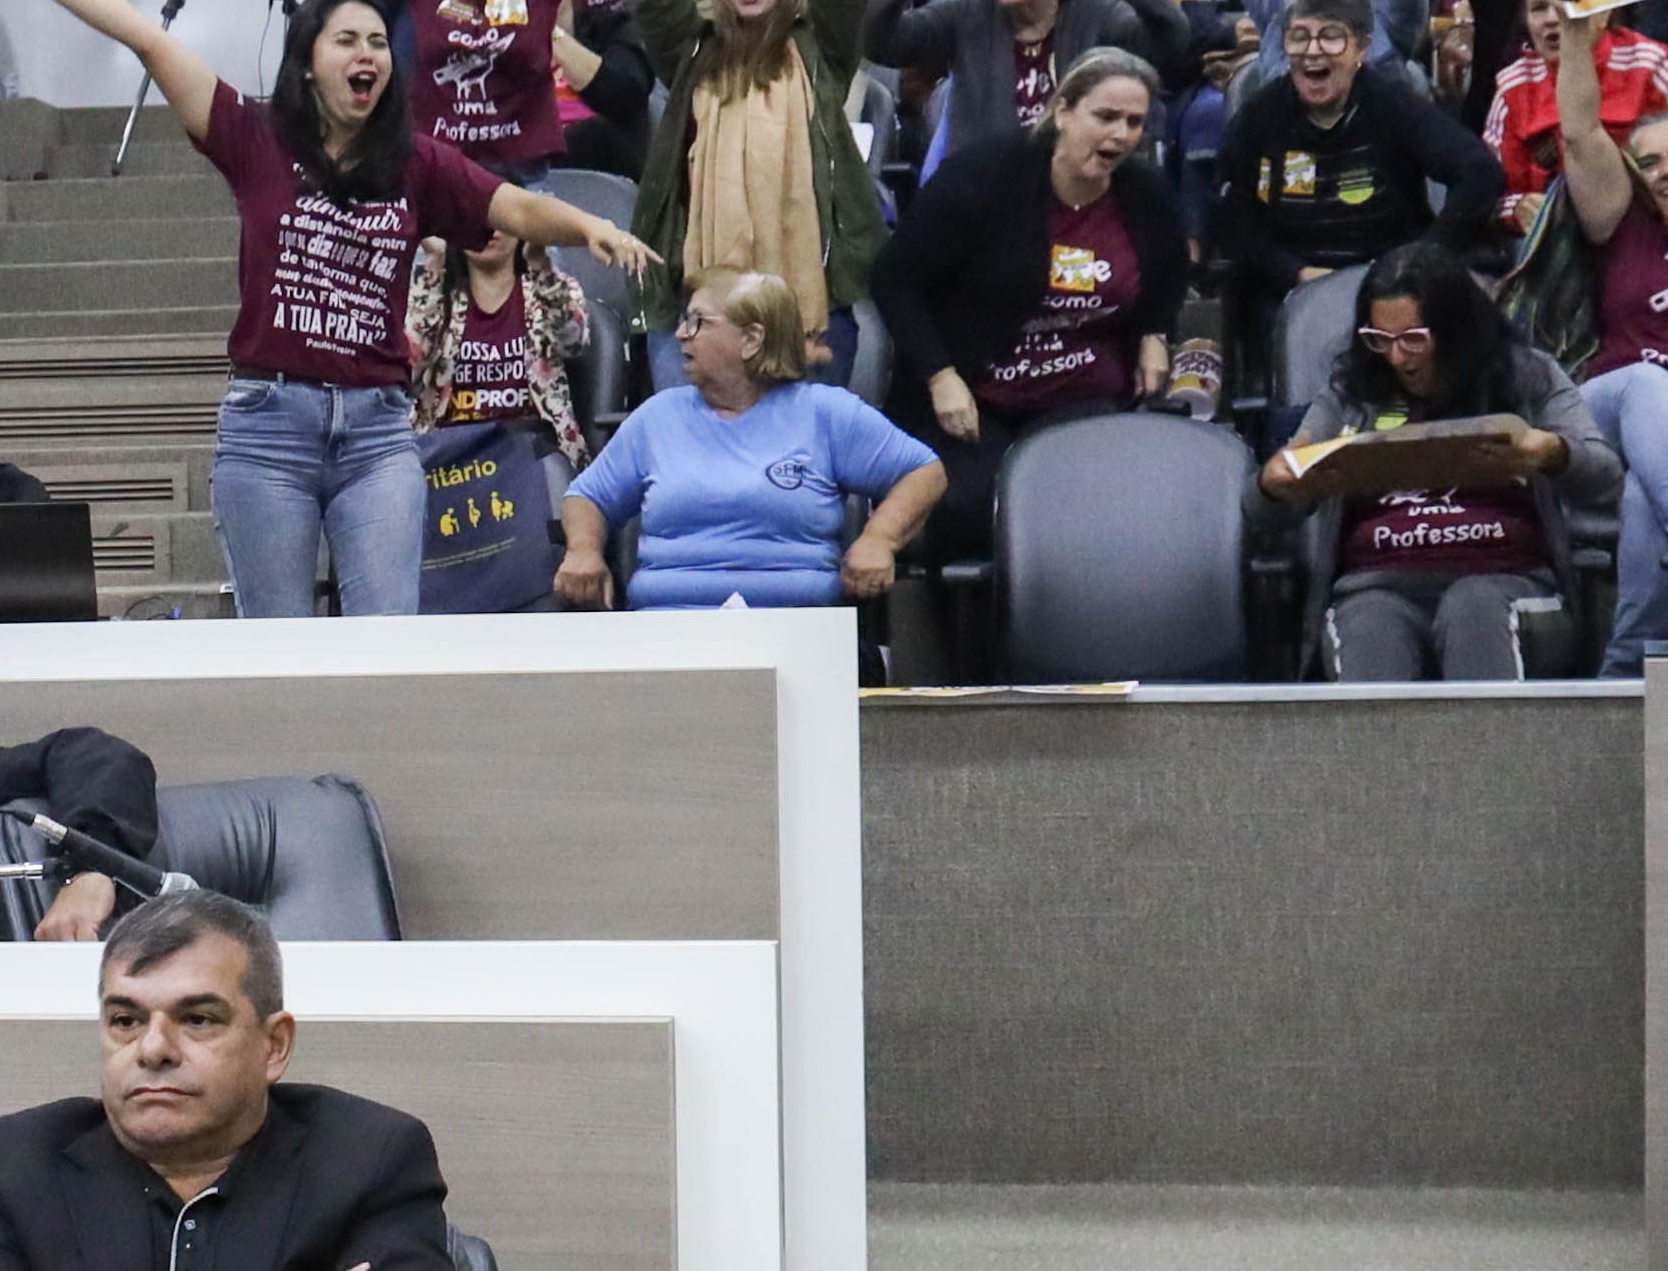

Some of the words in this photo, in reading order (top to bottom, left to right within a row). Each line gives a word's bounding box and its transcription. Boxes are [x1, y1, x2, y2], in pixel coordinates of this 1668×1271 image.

[447, 27, 500, 49] como
[452, 100, 499, 116] uma
[433, 116, 522, 142] Professora
[279, 213, 291, 226] a
[279, 250, 299, 265] de
[307, 235, 333, 259] diz
[270, 283, 283, 296] A
[284, 285, 316, 303] TUA
[349, 309, 386, 329] SEJA
[272, 301, 285, 329] A
[289, 305, 323, 335] TUA
[460, 340, 501, 362] OSSA
[476, 359, 525, 383] RESPO
[989, 346, 1097, 381] rofessora
[1374, 521, 1506, 549] Professora
